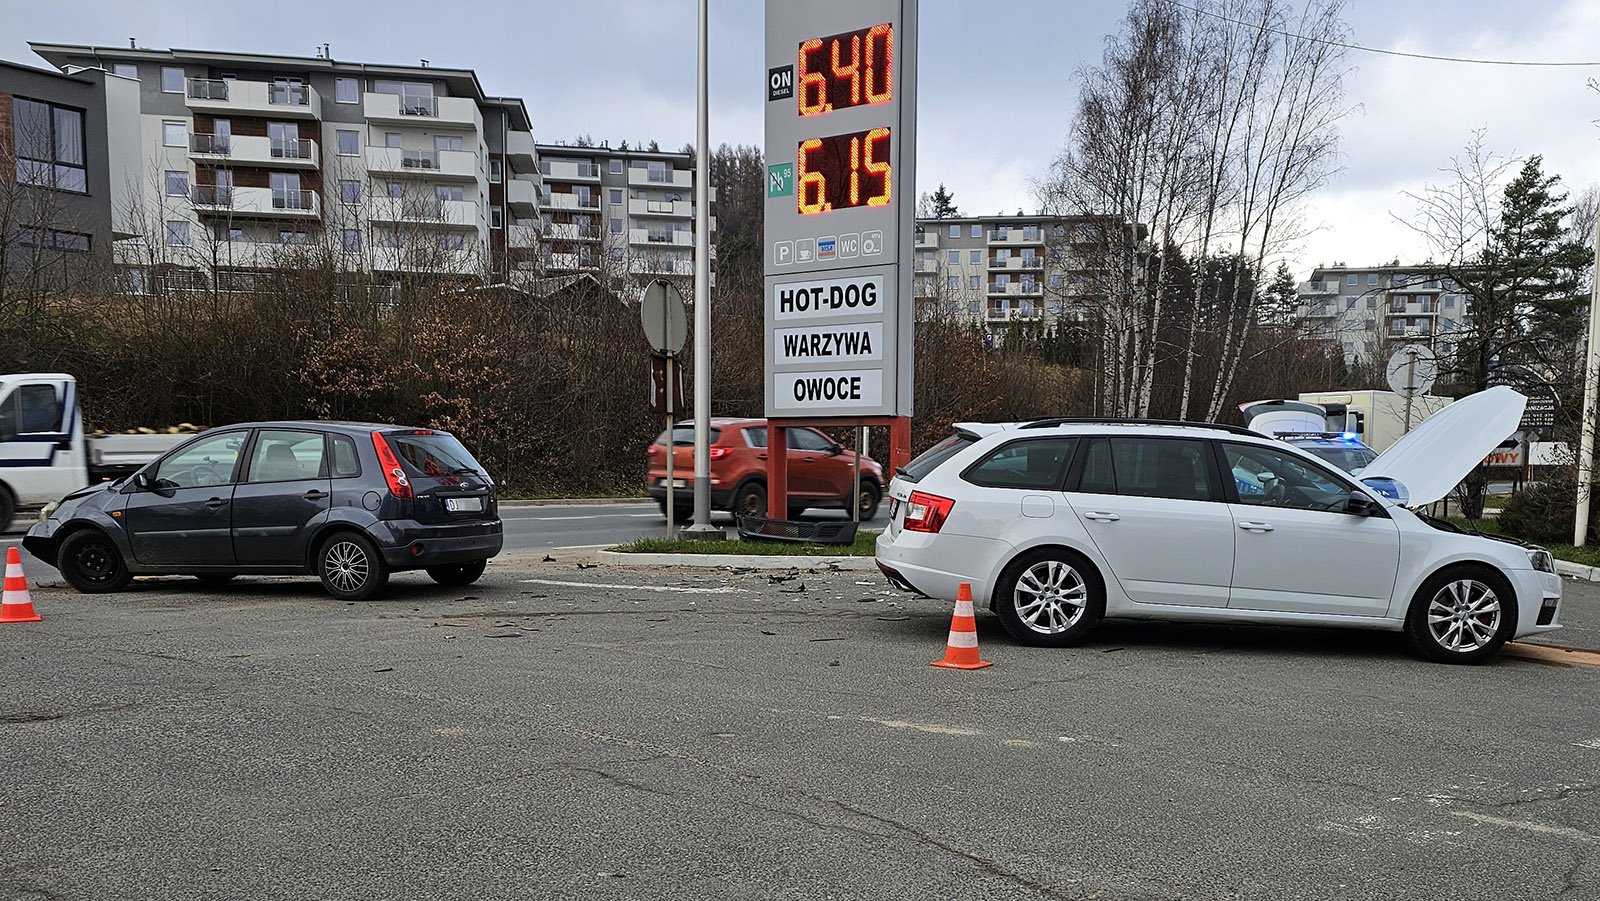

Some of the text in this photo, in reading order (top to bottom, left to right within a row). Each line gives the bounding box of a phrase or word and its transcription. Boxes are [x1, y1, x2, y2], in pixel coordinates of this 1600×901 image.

[771, 70, 791, 89] ON
[798, 23, 894, 116] 6.40
[772, 87, 790, 97] DIESEL
[798, 127, 892, 214] 6.15
[841, 239, 857, 253] WC
[780, 282, 877, 313] HOT-DOG
[783, 331, 872, 357] WARZYWA
[793, 376, 861, 402] OWOCE
